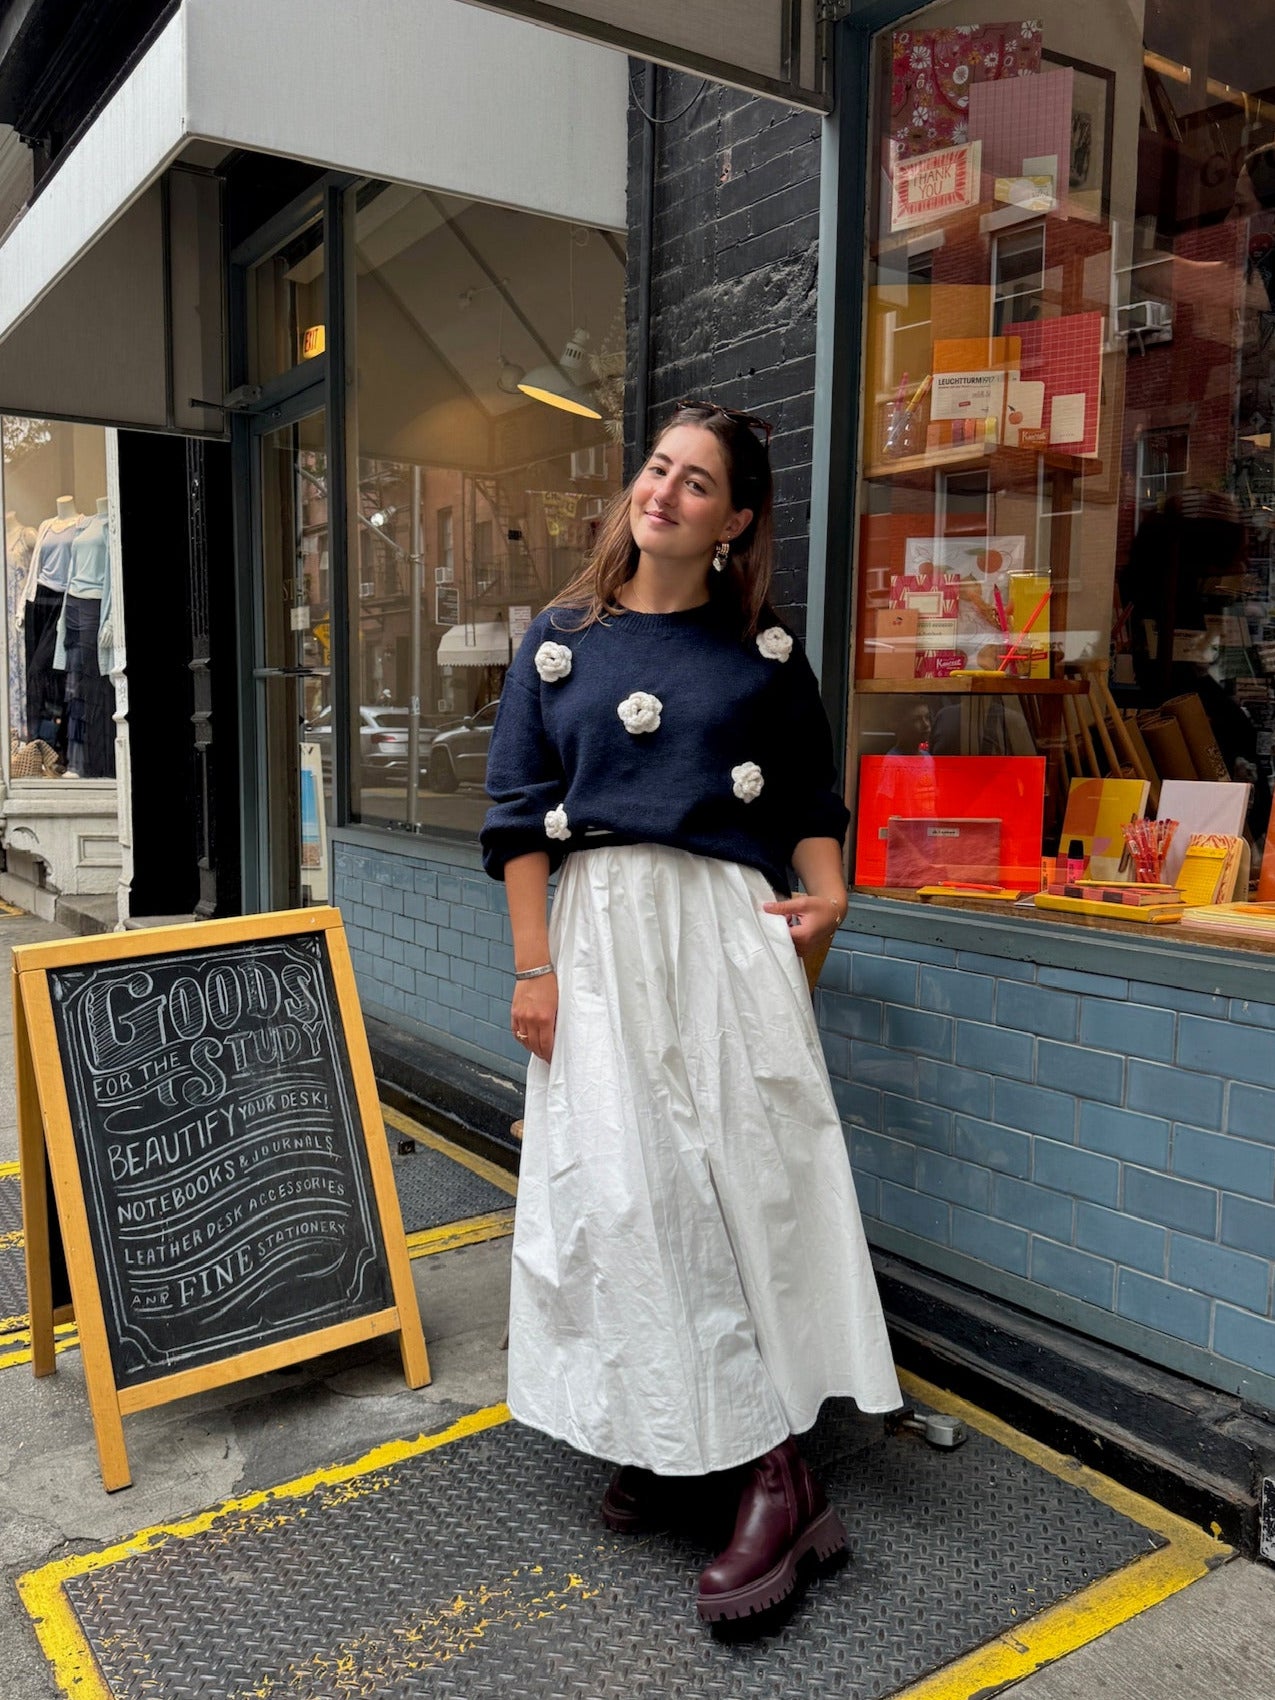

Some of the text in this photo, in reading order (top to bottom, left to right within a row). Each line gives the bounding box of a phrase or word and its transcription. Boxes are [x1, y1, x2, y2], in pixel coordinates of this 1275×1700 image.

[913, 166, 951, 187] THANK
[919, 181, 943, 199] YOU
[78, 961, 318, 1074] GOODS
[93, 1051, 181, 1099] FOR THE
[181, 1021, 325, 1107] STUDY
[107, 1103, 235, 1181] BEAUTIFY
[238, 1095, 276, 1120] YOUR
[117, 1135, 335, 1223] NOTEBOOKS & JOURNALS
[125, 1177, 345, 1265] LEATHER DESK ACCESSORIES
[131, 1220, 347, 1308] AND FINE STATIONERY
